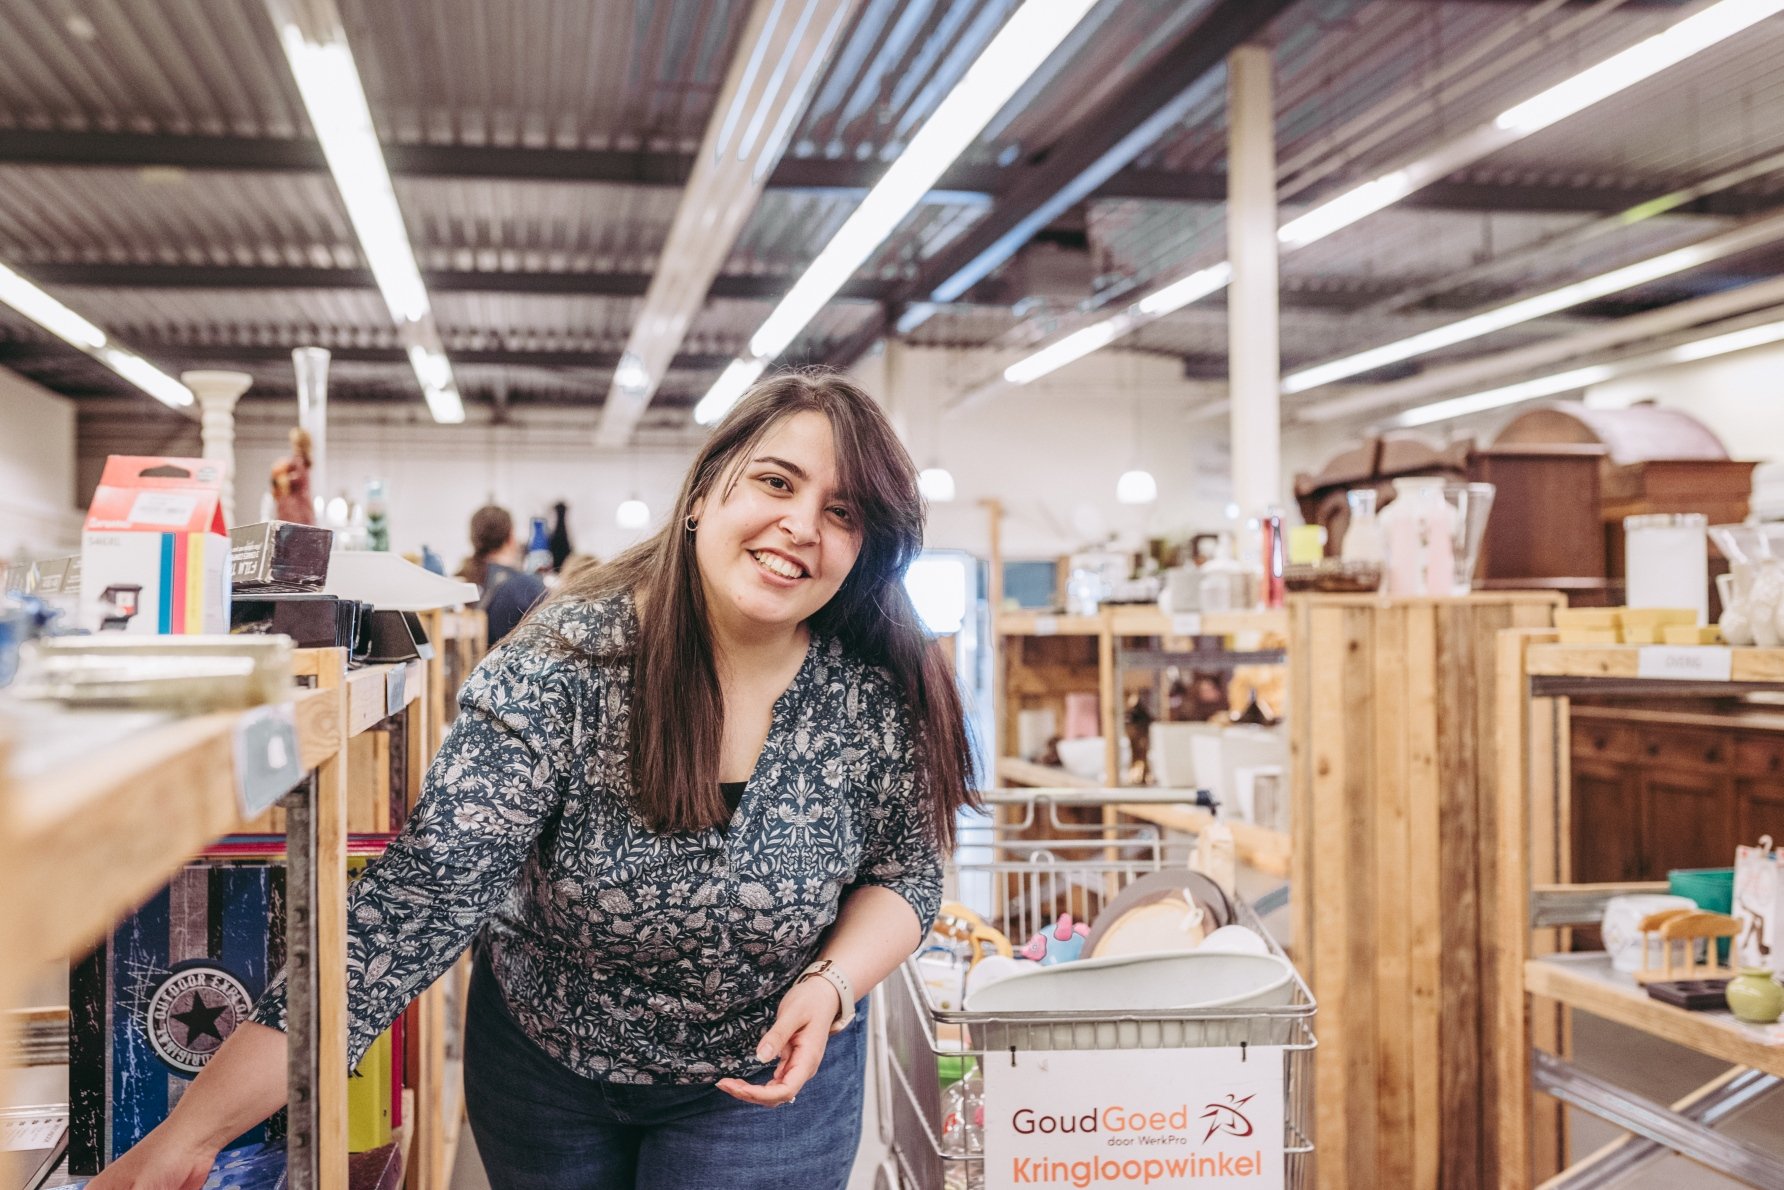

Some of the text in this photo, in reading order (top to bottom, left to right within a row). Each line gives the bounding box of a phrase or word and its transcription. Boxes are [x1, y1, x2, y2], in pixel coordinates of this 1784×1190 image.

[154, 973, 206, 1020] OUTDOOR
[1107, 1134, 1188, 1147] door WerkPro
[1012, 1150, 1263, 1189] Kringloopwinkel
